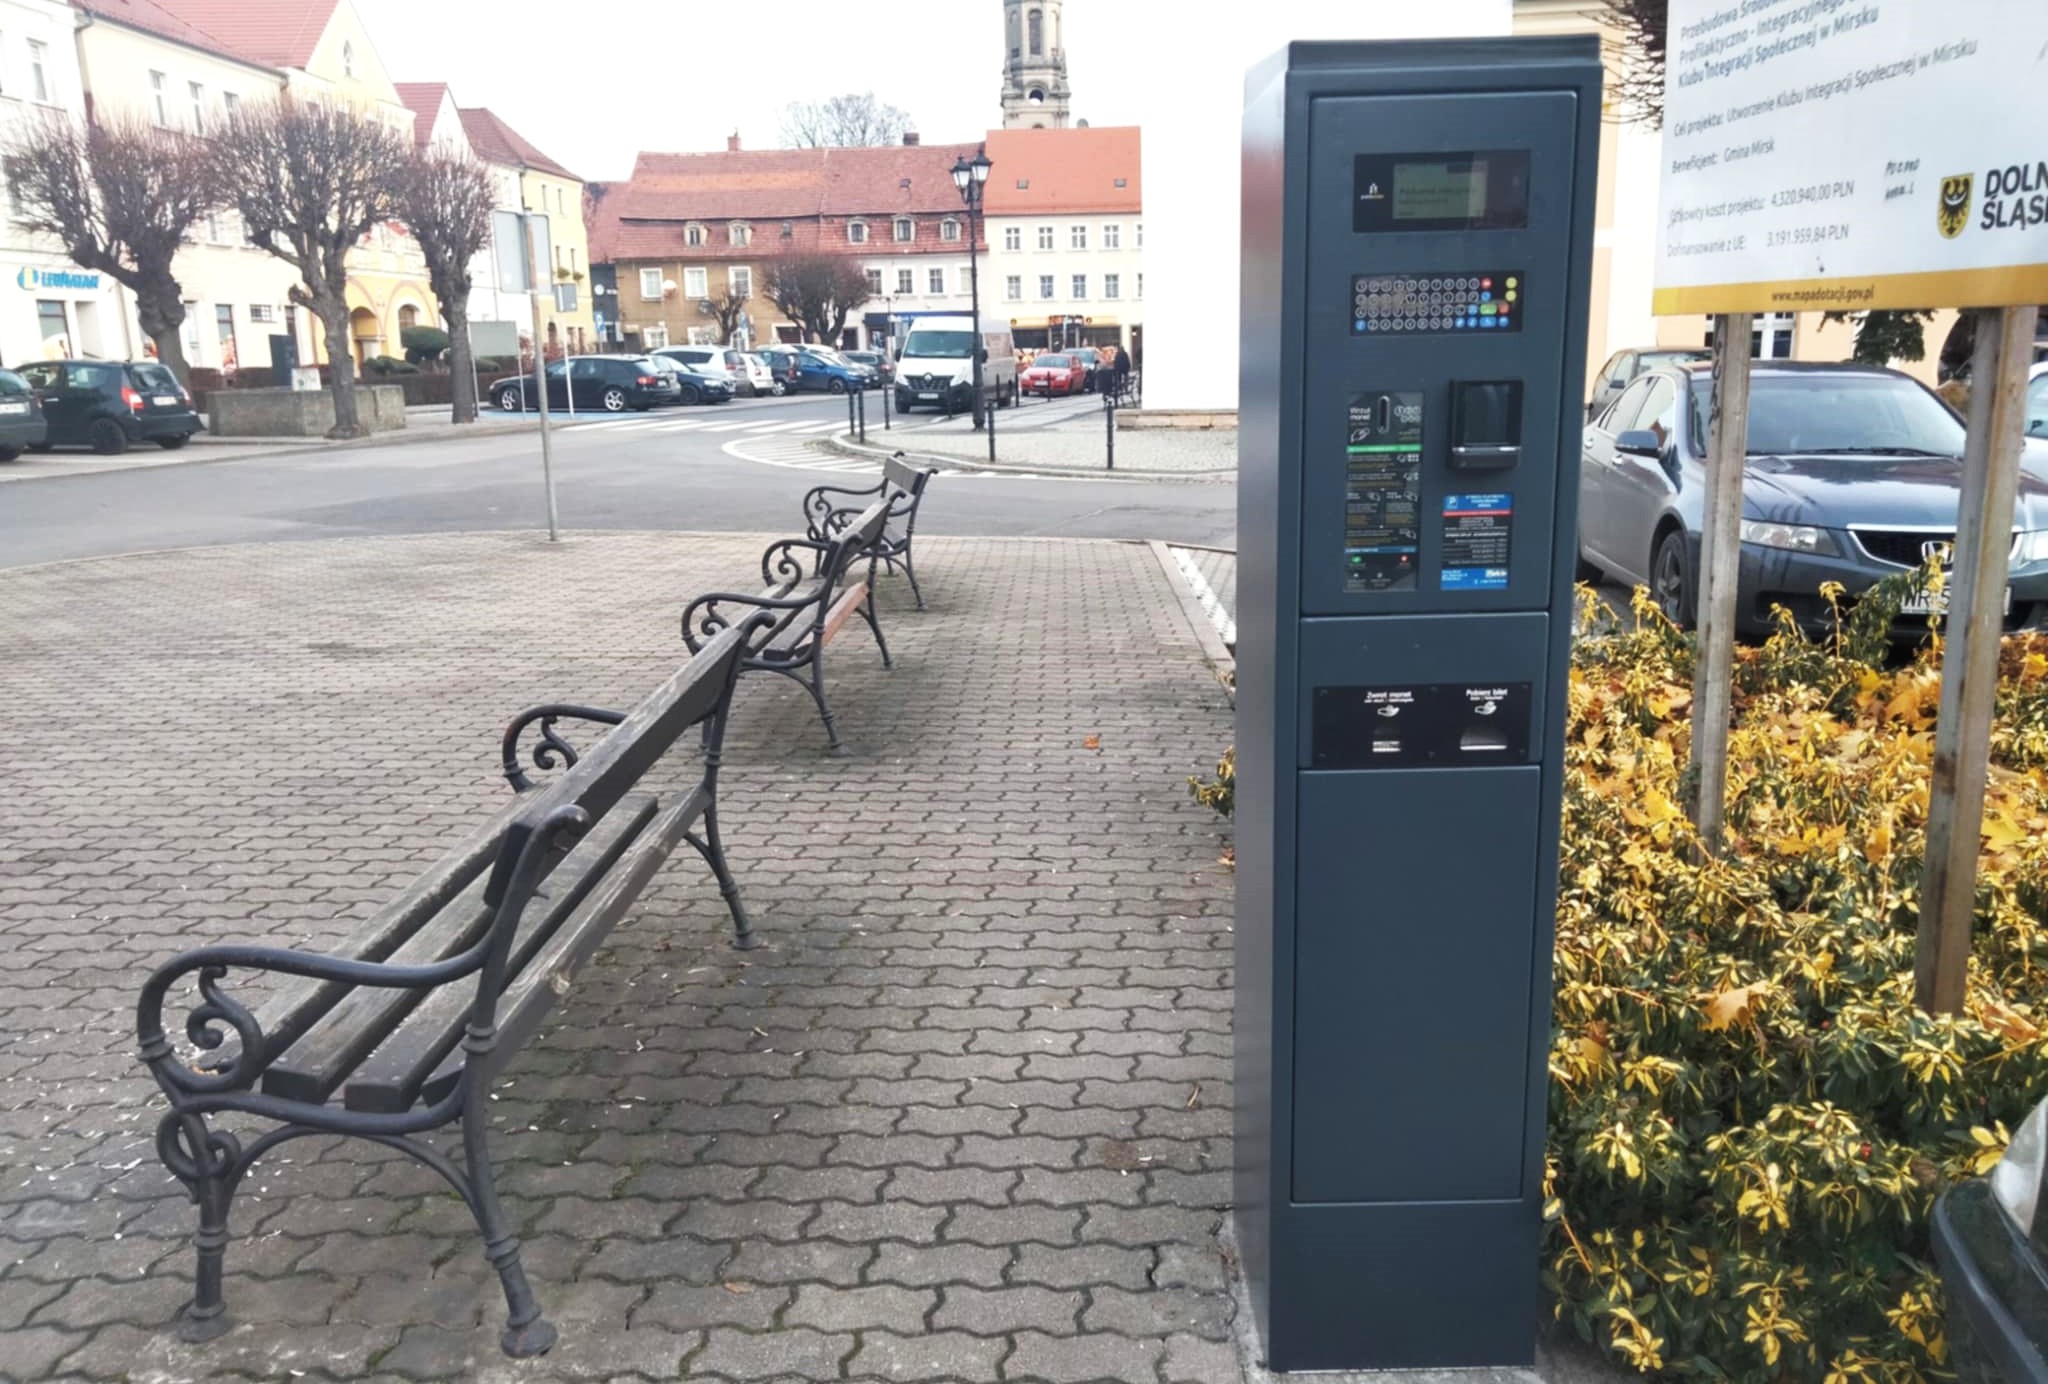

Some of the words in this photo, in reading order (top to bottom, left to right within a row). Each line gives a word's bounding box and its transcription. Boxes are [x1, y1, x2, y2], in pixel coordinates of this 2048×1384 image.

[1833, 5, 1879, 36] Mirsku
[1776, 89, 1803, 107] Klubu
[1855, 54, 1917, 88] Społecznej
[1919, 54, 1931, 68] w
[1932, 38, 1978, 64] Mirsku
[1724, 145, 1750, 163] Gmina
[1751, 136, 1775, 155] Mirsk
[1832, 180, 1855, 198] PLN
[1827, 224, 1850, 241] PLN
